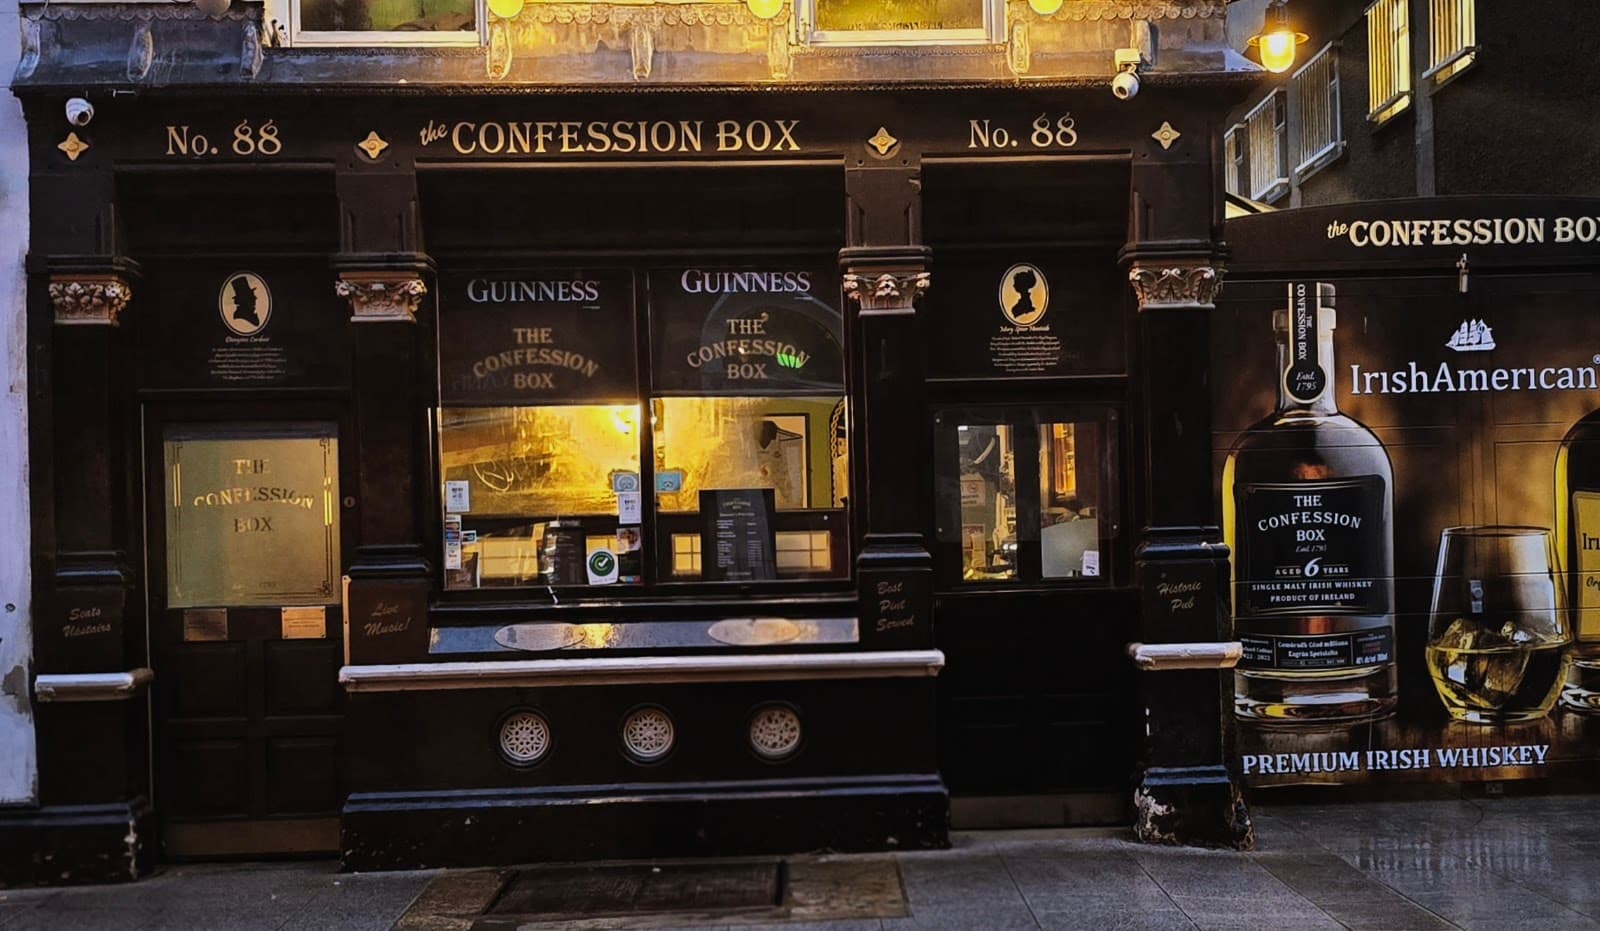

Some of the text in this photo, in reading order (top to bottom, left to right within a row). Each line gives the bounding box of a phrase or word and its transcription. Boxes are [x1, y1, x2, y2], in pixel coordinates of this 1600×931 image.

[166, 119, 282, 156] No. 88
[419, 119, 801, 154] the CONFESSION BOX
[968, 112, 1078, 149] No. 88
[1327, 216, 1600, 247] the CONFESSION BO
[467, 278, 600, 303] GUINNESS
[681, 269, 811, 293] GUINNESS
[726, 319, 768, 335] THE
[1297, 283, 1308, 360] CONFESSION BOX
[513, 328, 553, 344] THE
[473, 348, 599, 378] CONFESSION
[687, 340, 811, 370] CONFESSION
[513, 372, 555, 389] BOX
[727, 363, 769, 380] BOX
[232, 459, 272, 475] THE
[194, 486, 314, 510] CONFESSION
[1293, 495, 1323, 508] THE
[233, 516, 273, 533] BOX
[1257, 511, 1362, 532] CONFESSION
[1296, 529, 1326, 542] BOX
[1304, 556, 1323, 578] 6
[1322, 566, 1350, 574] YEARS
[1156, 581, 1201, 596] Historic
[1251, 580, 1373, 591] SINGLE MALT IRISH WHISKEY
[1170, 595, 1195, 613] Pub
[1270, 592, 1356, 603] PRODUCT OF IRELAND
[1242, 744, 1549, 776] PREMIUM IRISH WHISKEY
